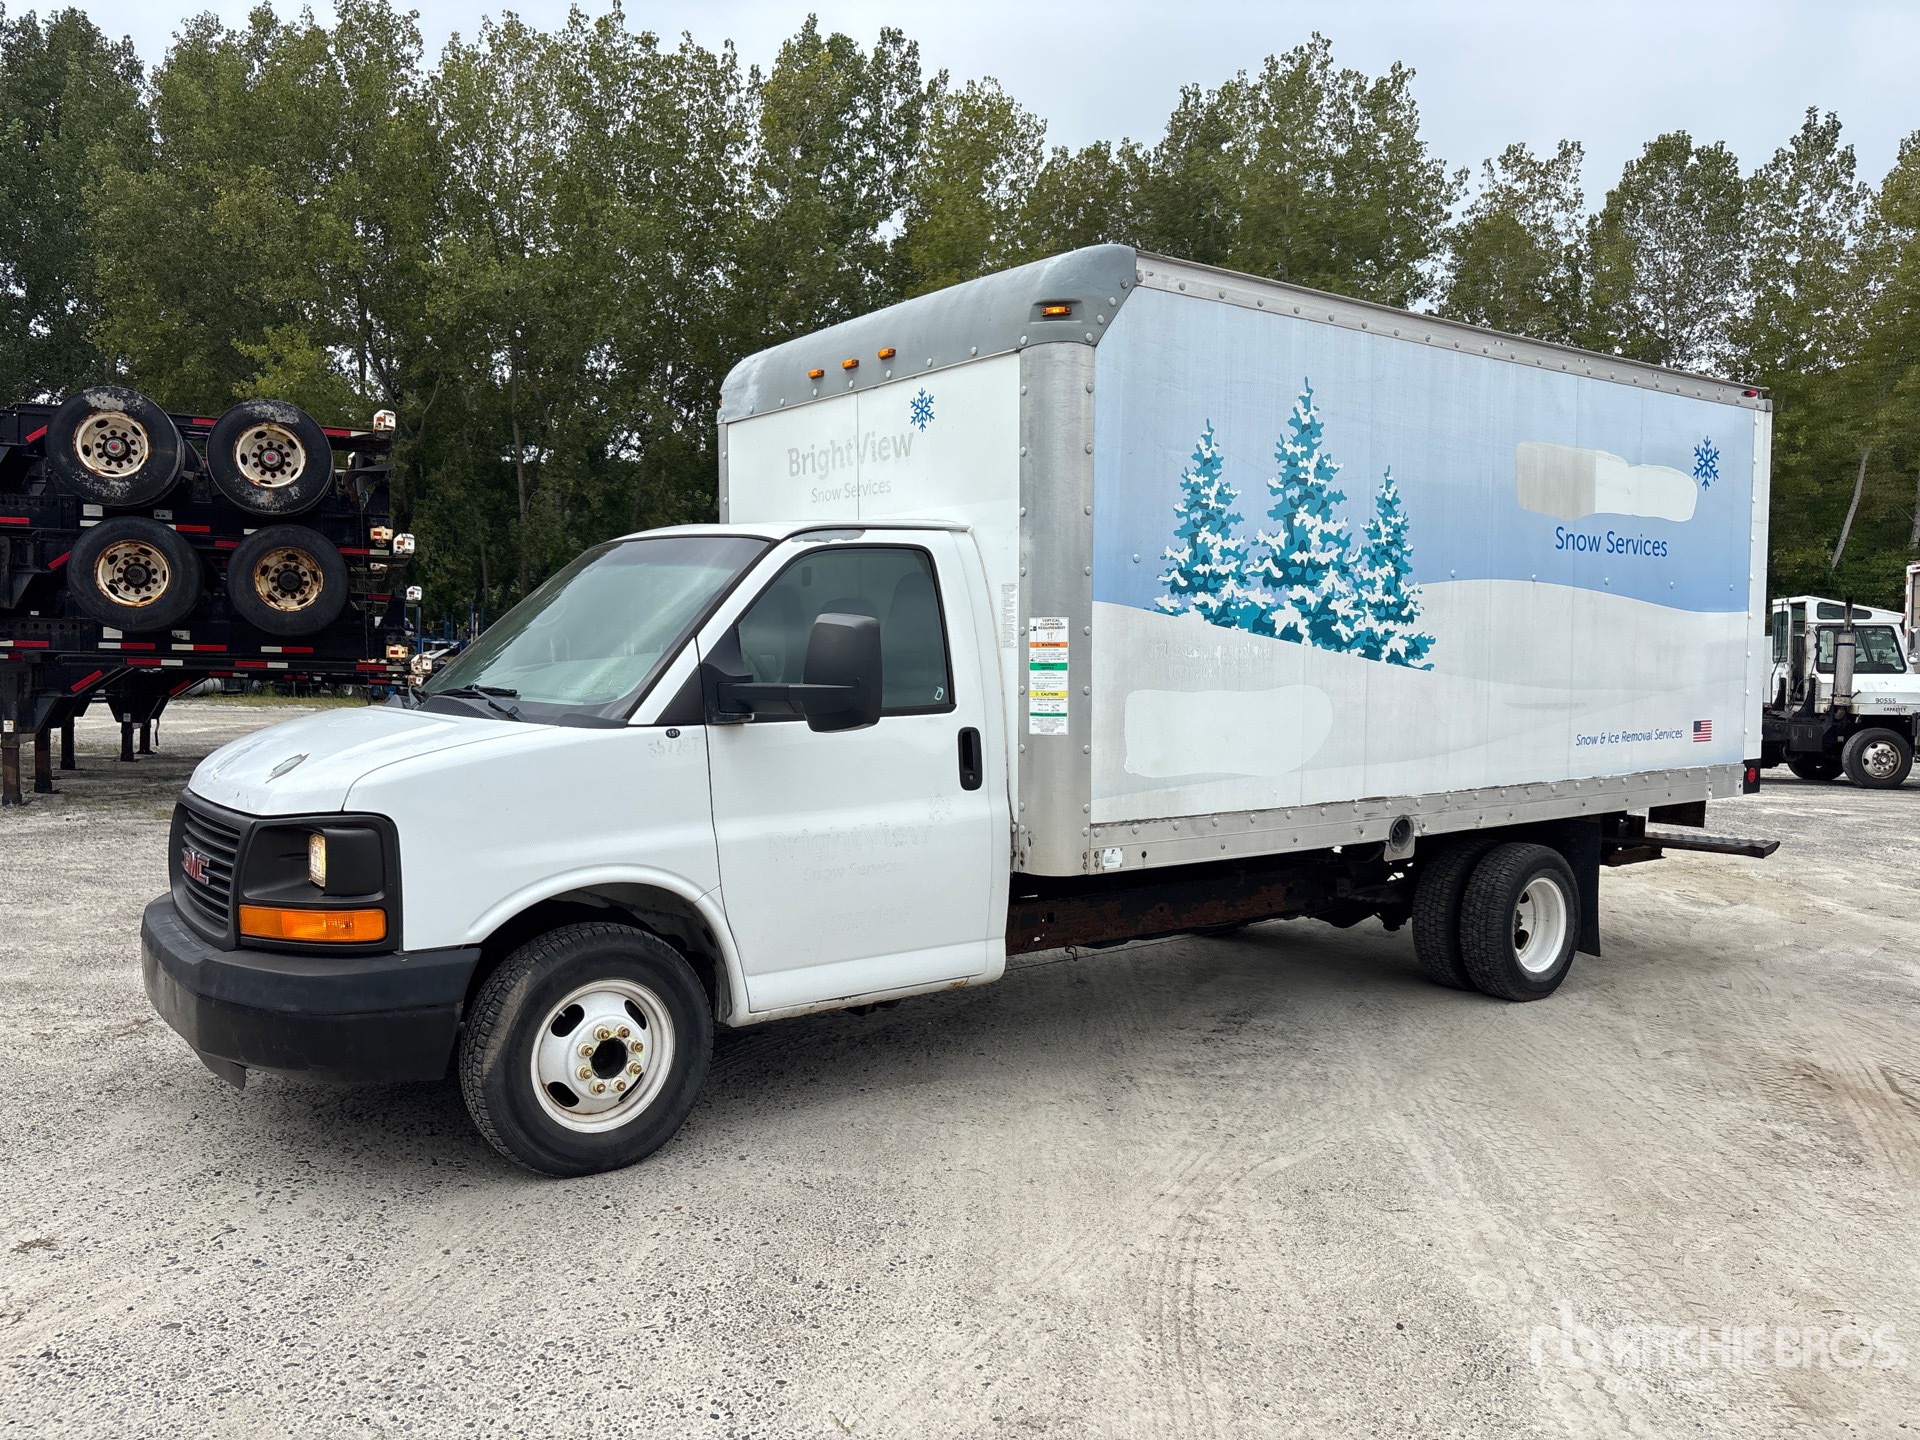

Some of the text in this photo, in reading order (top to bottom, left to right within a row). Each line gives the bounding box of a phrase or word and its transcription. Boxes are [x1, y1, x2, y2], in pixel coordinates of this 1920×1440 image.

[788, 431, 914, 480] BrightView
[811, 480, 891, 503] Snow Services
[1555, 526, 1667, 557] Snow Services
[1576, 727, 1683, 746] Snow & Ice Removal Services
[181, 848, 210, 885] GMC
